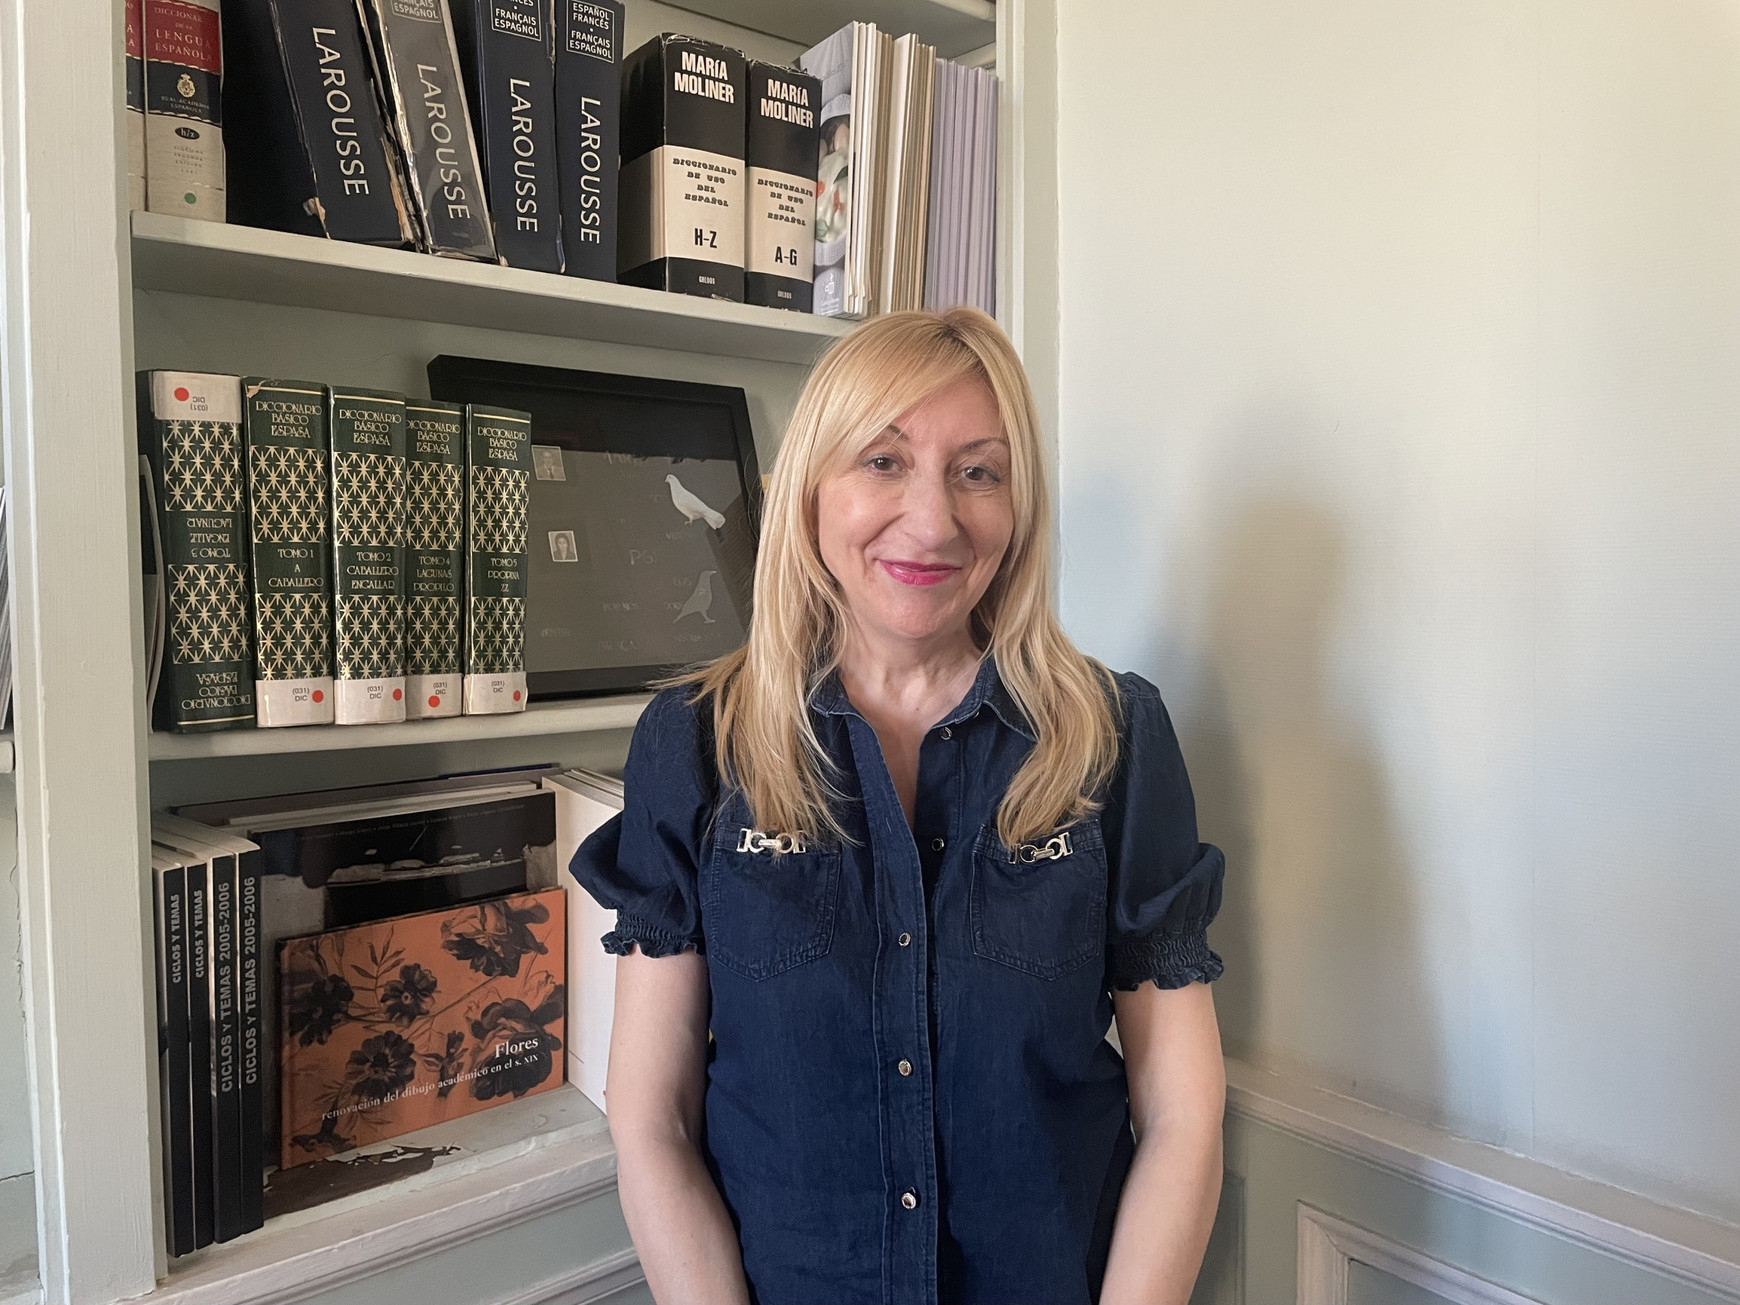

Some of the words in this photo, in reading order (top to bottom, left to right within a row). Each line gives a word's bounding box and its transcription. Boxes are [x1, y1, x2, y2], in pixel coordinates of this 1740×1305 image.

[393, 2, 439, 19] ESPAGNOL
[496, 8, 536, 26] FRANÇAIS
[573, 2, 610, 20] ESPAÑOL
[494, 18, 538, 36] ESPAGNOL
[573, 12, 609, 30] FRANCÉS
[156, 28, 211, 48] LENGUA
[571, 30, 610, 48] FRANÇAIS
[155, 42, 212, 62] ESPAÑOLA
[570, 40, 612, 58] ESPAGNOL
[674, 72, 735, 104] MOLINER
[312, 27, 370, 196] LAROUSSE
[760, 98, 814, 129] MOLINER
[416, 64, 470, 219] LAROUSSE
[510, 78, 538, 232] LAROUSSE
[580, 96, 601, 244] LAROUSSE
[672, 158, 737, 176] DICCIONARIO
[687, 171, 700, 180] DE
[707, 174, 726, 184] USO
[697, 184, 716, 194] DEL
[758, 178, 814, 198] DICCIONARIO
[684, 193, 729, 207] ESPAÑOL
[770, 192, 782, 200] DE
[787, 195, 804, 204] USO
[778, 204, 796, 213] DEL
[767, 212, 806, 226] ESPAÑOL
[694, 228, 718, 248] H-Z
[774, 246, 798, 266] A-G
[256, 400, 322, 416] DICCIONARIO
[272, 412, 309, 426] BÁSICO
[340, 409, 401, 424] DICCIONARIO
[271, 425, 311, 438] ESPASA
[354, 420, 389, 432] BÁSICO
[406, 420, 460, 434] DICCIONARIO
[478, 426, 527, 440] DICCIONARIO
[354, 432, 390, 446] ESPASA
[418, 430, 450, 442] BÁSICO
[490, 437, 517, 450] BÁSICO
[416, 442, 450, 454] ESPASA
[488, 448, 518, 461] ESPASA
[191, 548, 198, 558] 3
[200, 548, 230, 558] TOMO
[278, 548, 308, 558] TOMO
[310, 549, 314, 558] 1
[356, 552, 384, 562] TOMO
[386, 552, 391, 562] 2
[419, 556, 446, 566] TOMO
[294, 564, 300, 572] A
[490, 558, 514, 566] TOMO
[514, 558, 518, 566] 5
[346, 566, 398, 576] CABALLERO
[268, 578, 324, 588] CABALLERO
[196, 672, 238, 685] ESPASA
[182, 694, 250, 710] DICCIONARIO
[170, 894, 180, 932] TEMAS
[194, 890, 203, 927] TEMAS
[244, 876, 256, 954] 2005-2006
[219, 882, 230, 961] 2005-2006
[172, 944, 181, 983] CICLOS
[196, 940, 204, 978] CICLOS
[220, 965, 231, 1020] TEMAS
[245, 958, 256, 1014] TEMAS
[222, 1024, 232, 1033] Y
[246, 1017, 256, 1026] Y
[494, 1038, 539, 1058] Flores
[220, 1036, 233, 1092] CICLOS
[246, 1030, 257, 1084] CICLOS
[322, 1097, 380, 1120] renovación
[384, 1090, 400, 1103] del
[402, 1082, 435, 1098] dibujo
[438, 1068, 488, 1088] académico
[490, 1064, 502, 1073] en
[504, 1058, 512, 1069] el
[524, 1054, 539, 1064] XIX
